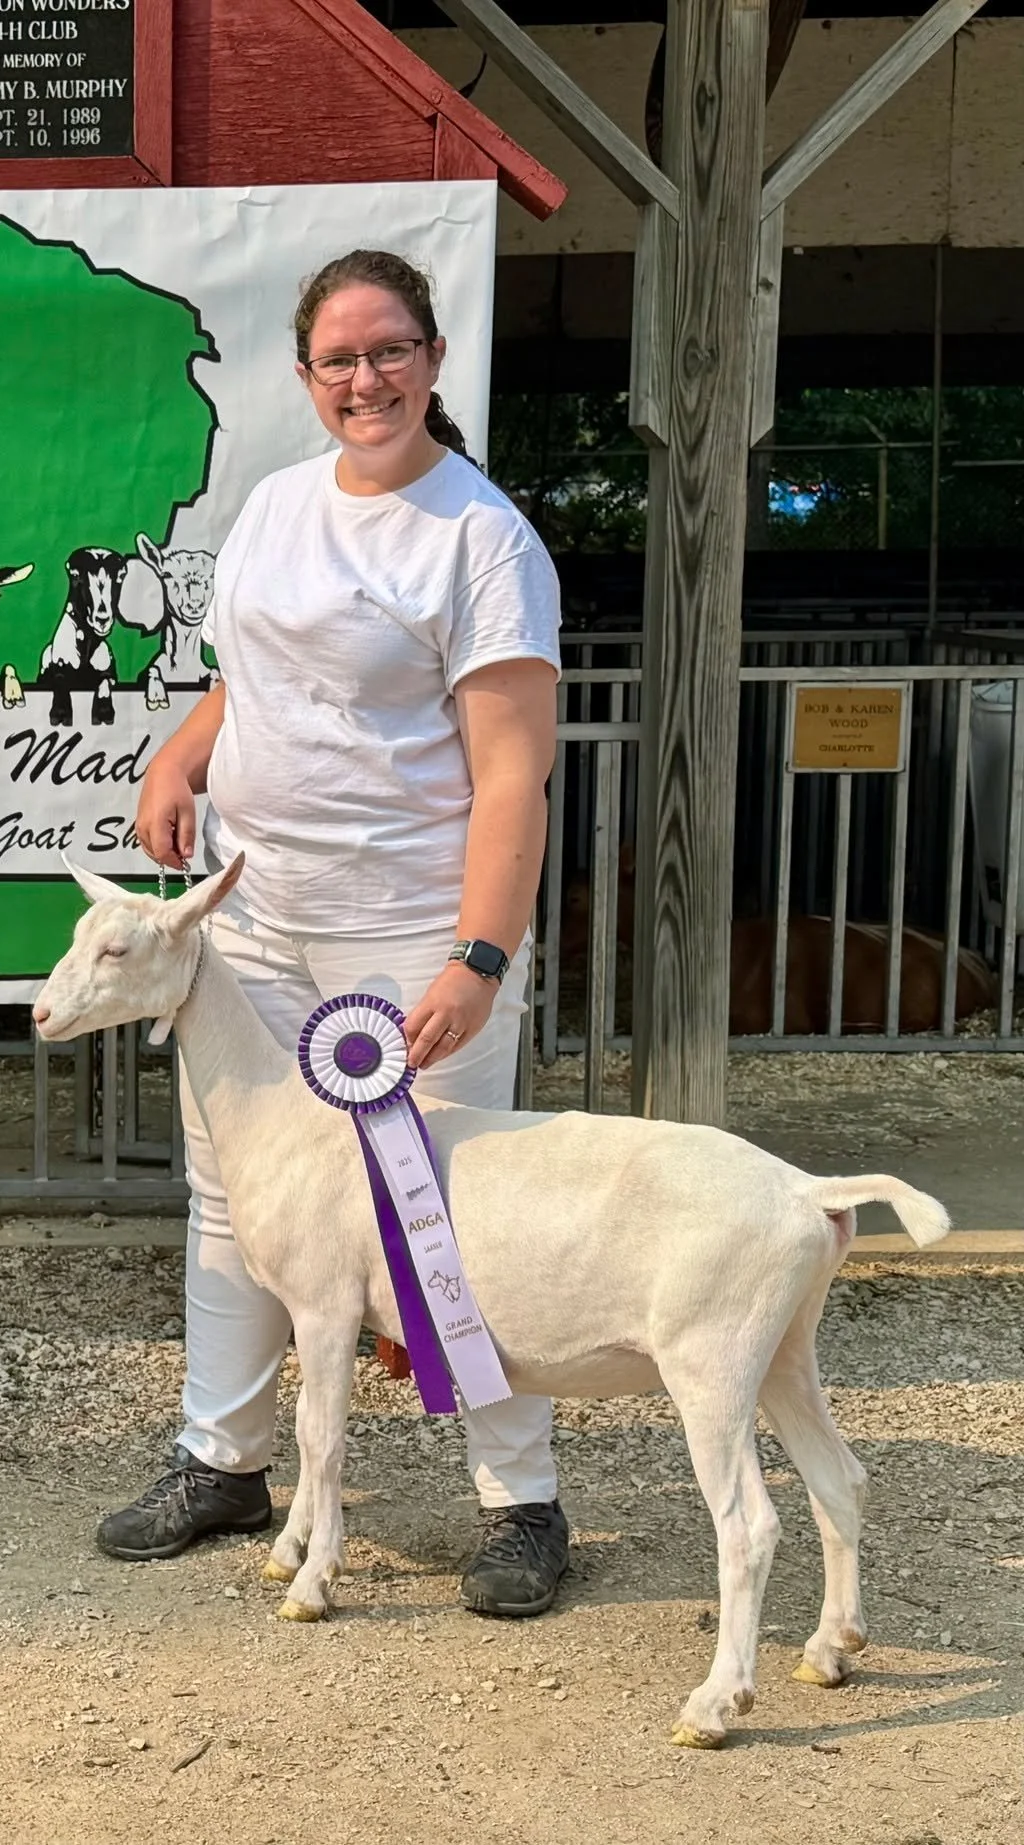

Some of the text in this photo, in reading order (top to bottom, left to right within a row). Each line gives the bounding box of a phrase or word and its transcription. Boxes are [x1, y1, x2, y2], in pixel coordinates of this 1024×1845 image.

[28, 20, 78, 40] CLUB
[3, 53, 63, 68] MEMORY
[66, 53, 86, 67] OF
[23, 81, 40, 100] B.
[45, 78, 128, 99] MURPHY
[63, 107, 101, 125] 1989
[63, 128, 101, 146] 1996
[804, 703, 894, 714] BOB & KAREN
[829, 719, 868, 728] WOOD
[4, 728, 151, 785] Mad
[818, 744, 875, 752] CHARLOTTE
[86, 816, 142, 852] Sh
[408, 1211, 444, 1235] ADGA
[445, 1315, 473, 1332] GRAND
[443, 1324, 483, 1343] CHAMPION
